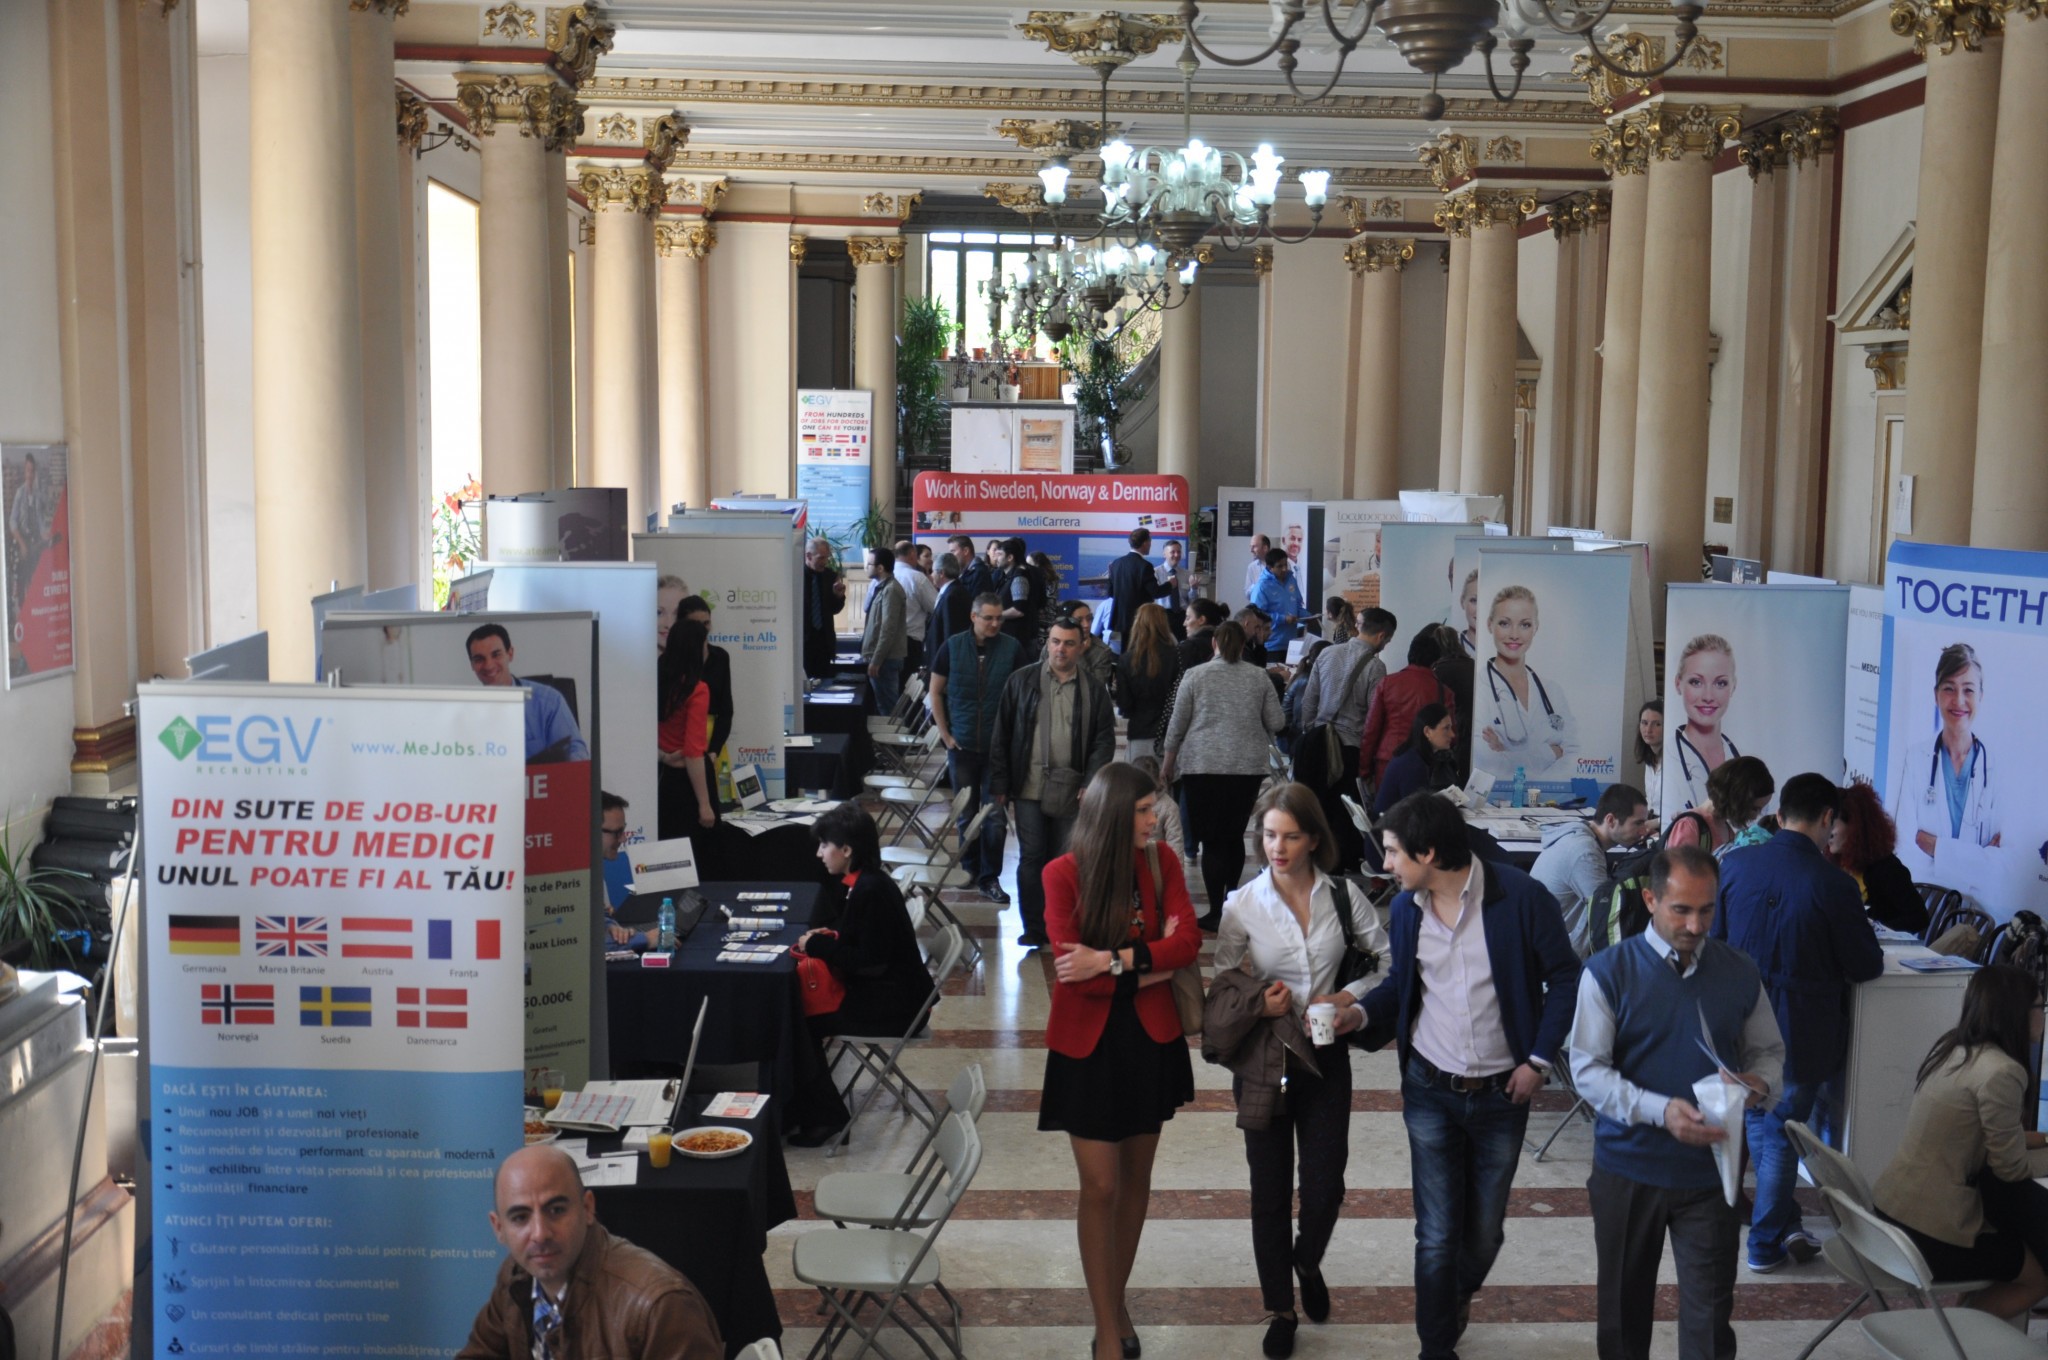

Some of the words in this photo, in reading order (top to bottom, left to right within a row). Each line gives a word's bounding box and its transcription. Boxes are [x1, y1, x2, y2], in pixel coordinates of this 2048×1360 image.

[925, 479, 962, 499] Work
[964, 480, 977, 499] in
[980, 480, 1038, 502] Sweden,
[1041, 481, 1096, 504] Norway
[1098, 485, 1109, 500] &
[1112, 481, 1178, 502] Denmark
[1018, 515, 1081, 528] MediCarrera
[727, 587, 777, 603] ateam
[743, 631, 755, 643] in
[757, 630, 777, 643] Alb
[196, 715, 322, 764] EGV
[351, 740, 508, 757] www.MeJobs.Ro
[1577, 757, 1608, 765] Careers
[196, 766, 308, 776] RECRUITING
[171, 798, 224, 819] DIN
[234, 799, 315, 820] SUTE
[324, 801, 365, 822] DE
[373, 802, 497, 824] JOB-URI
[175, 828, 339, 857] PENTRU
[352, 831, 494, 860] MEDICI
[158, 865, 239, 887] UNUL
[250, 866, 349, 888] POATE
[358, 868, 385, 889] FI
[394, 869, 432, 890] AL
[444, 866, 515, 891] TĂU!
[539, 881, 553, 892] de
[555, 878, 581, 890] Paris
[544, 903, 575, 916] Reims
[529, 940, 548, 951] aux
[551, 936, 578, 949] Lions
[182, 963, 227, 974] Germania
[258, 965, 288, 974] Marea
[290, 966, 325, 975] Britanie
[362, 967, 394, 976] Austria
[218, 1033, 259, 1043] Norvegia
[321, 1036, 351, 1045] Suedia
[407, 1036, 458, 1047] Danemarca
[163, 1083, 196, 1096] DACĂ
[236, 1083, 249, 1096] ÎN
[254, 1083, 328, 1098] CĂUTAREA:
[178, 1106, 205, 1118] Unui
[209, 1109, 231, 1118] nou
[235, 1107, 259, 1118] JOB
[276, 1110, 284, 1118] a
[287, 1109, 313, 1119] unei
[317, 1108, 335, 1119] noi
[346, 1128, 419, 1141] profesionale
[179, 1144, 205, 1155] Unui
[209, 1145, 245, 1155] mediu
[248, 1145, 263, 1155] de
[267, 1145, 296, 1156] lucru
[300, 1146, 364, 1161] performant
[368, 1149, 382, 1158] cu
[385, 1148, 441, 1160] aparatură
[444, 1148, 495, 1160] modernă
[179, 1163, 205, 1175] Unui
[209, 1163, 261, 1175] echilibru
[328, 1166, 383, 1178] personală
[400, 1169, 419, 1178] cea
[248, 1183, 308, 1195] financiare
[165, 1215, 211, 1226] ATUNCI
[239, 1216, 284, 1228] PUTEM
[288, 1217, 333, 1228] OFERI:
[241, 1244, 320, 1257] personalizată
[323, 1247, 330, 1255] a
[383, 1246, 426, 1259] potrivit
[430, 1247, 468, 1260] pentru
[472, 1248, 497, 1259] tine
[191, 1309, 207, 1320] Un
[211, 1309, 273, 1320] consultant
[276, 1310, 319, 1321] dedicat
[323, 1311, 362, 1323] pentru
[367, 1312, 390, 1322] tine
[189, 1341, 232, 1353] Cursuri
[236, 1342, 247, 1353] de
[251, 1342, 279, 1353] limbi
[323, 1344, 360, 1357] pentru
